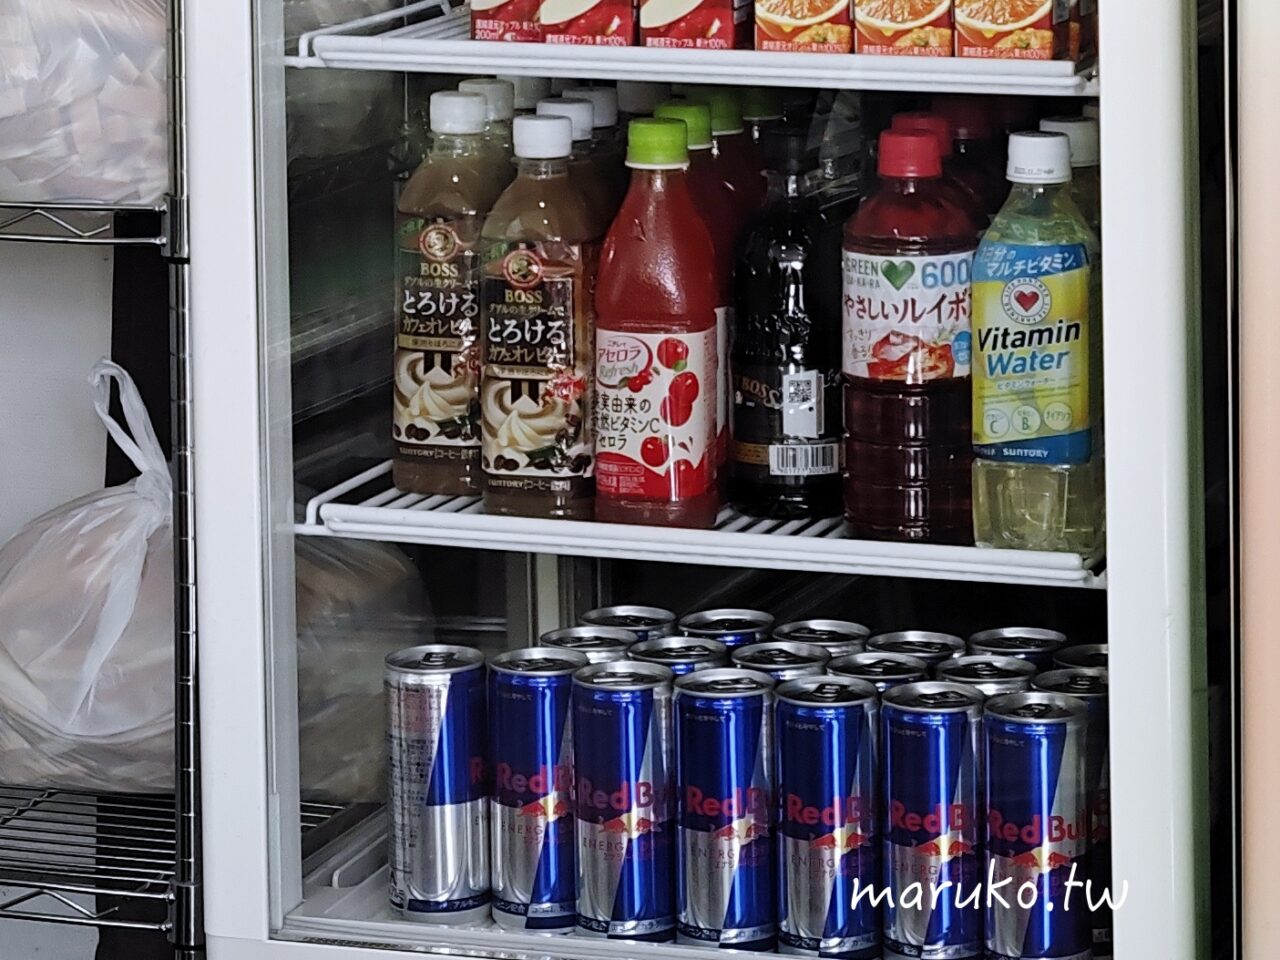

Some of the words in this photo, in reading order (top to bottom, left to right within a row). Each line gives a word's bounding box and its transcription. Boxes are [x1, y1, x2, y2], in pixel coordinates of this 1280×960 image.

[420, 262, 459, 277] BOSS
[921, 259, 970, 289] 600
[402, 290, 479, 317] とろける
[504, 289, 543, 304] BOSS
[843, 288, 972, 324] やさしいルイボ
[487, 317, 566, 345] とろける
[977, 319, 1080, 353] Vitamin
[598, 345, 642, 363] アセロラ
[987, 350, 1070, 377] Water
[496, 761, 554, 794] Red
[579, 776, 629, 811] Red
[686, 785, 743, 817] Red
[786, 793, 842, 827] Red
[891, 799, 944, 834] Red
[987, 808, 1042, 846] Red
[583, 837, 625, 852] ENERG
[791, 855, 835, 869] ENERG
